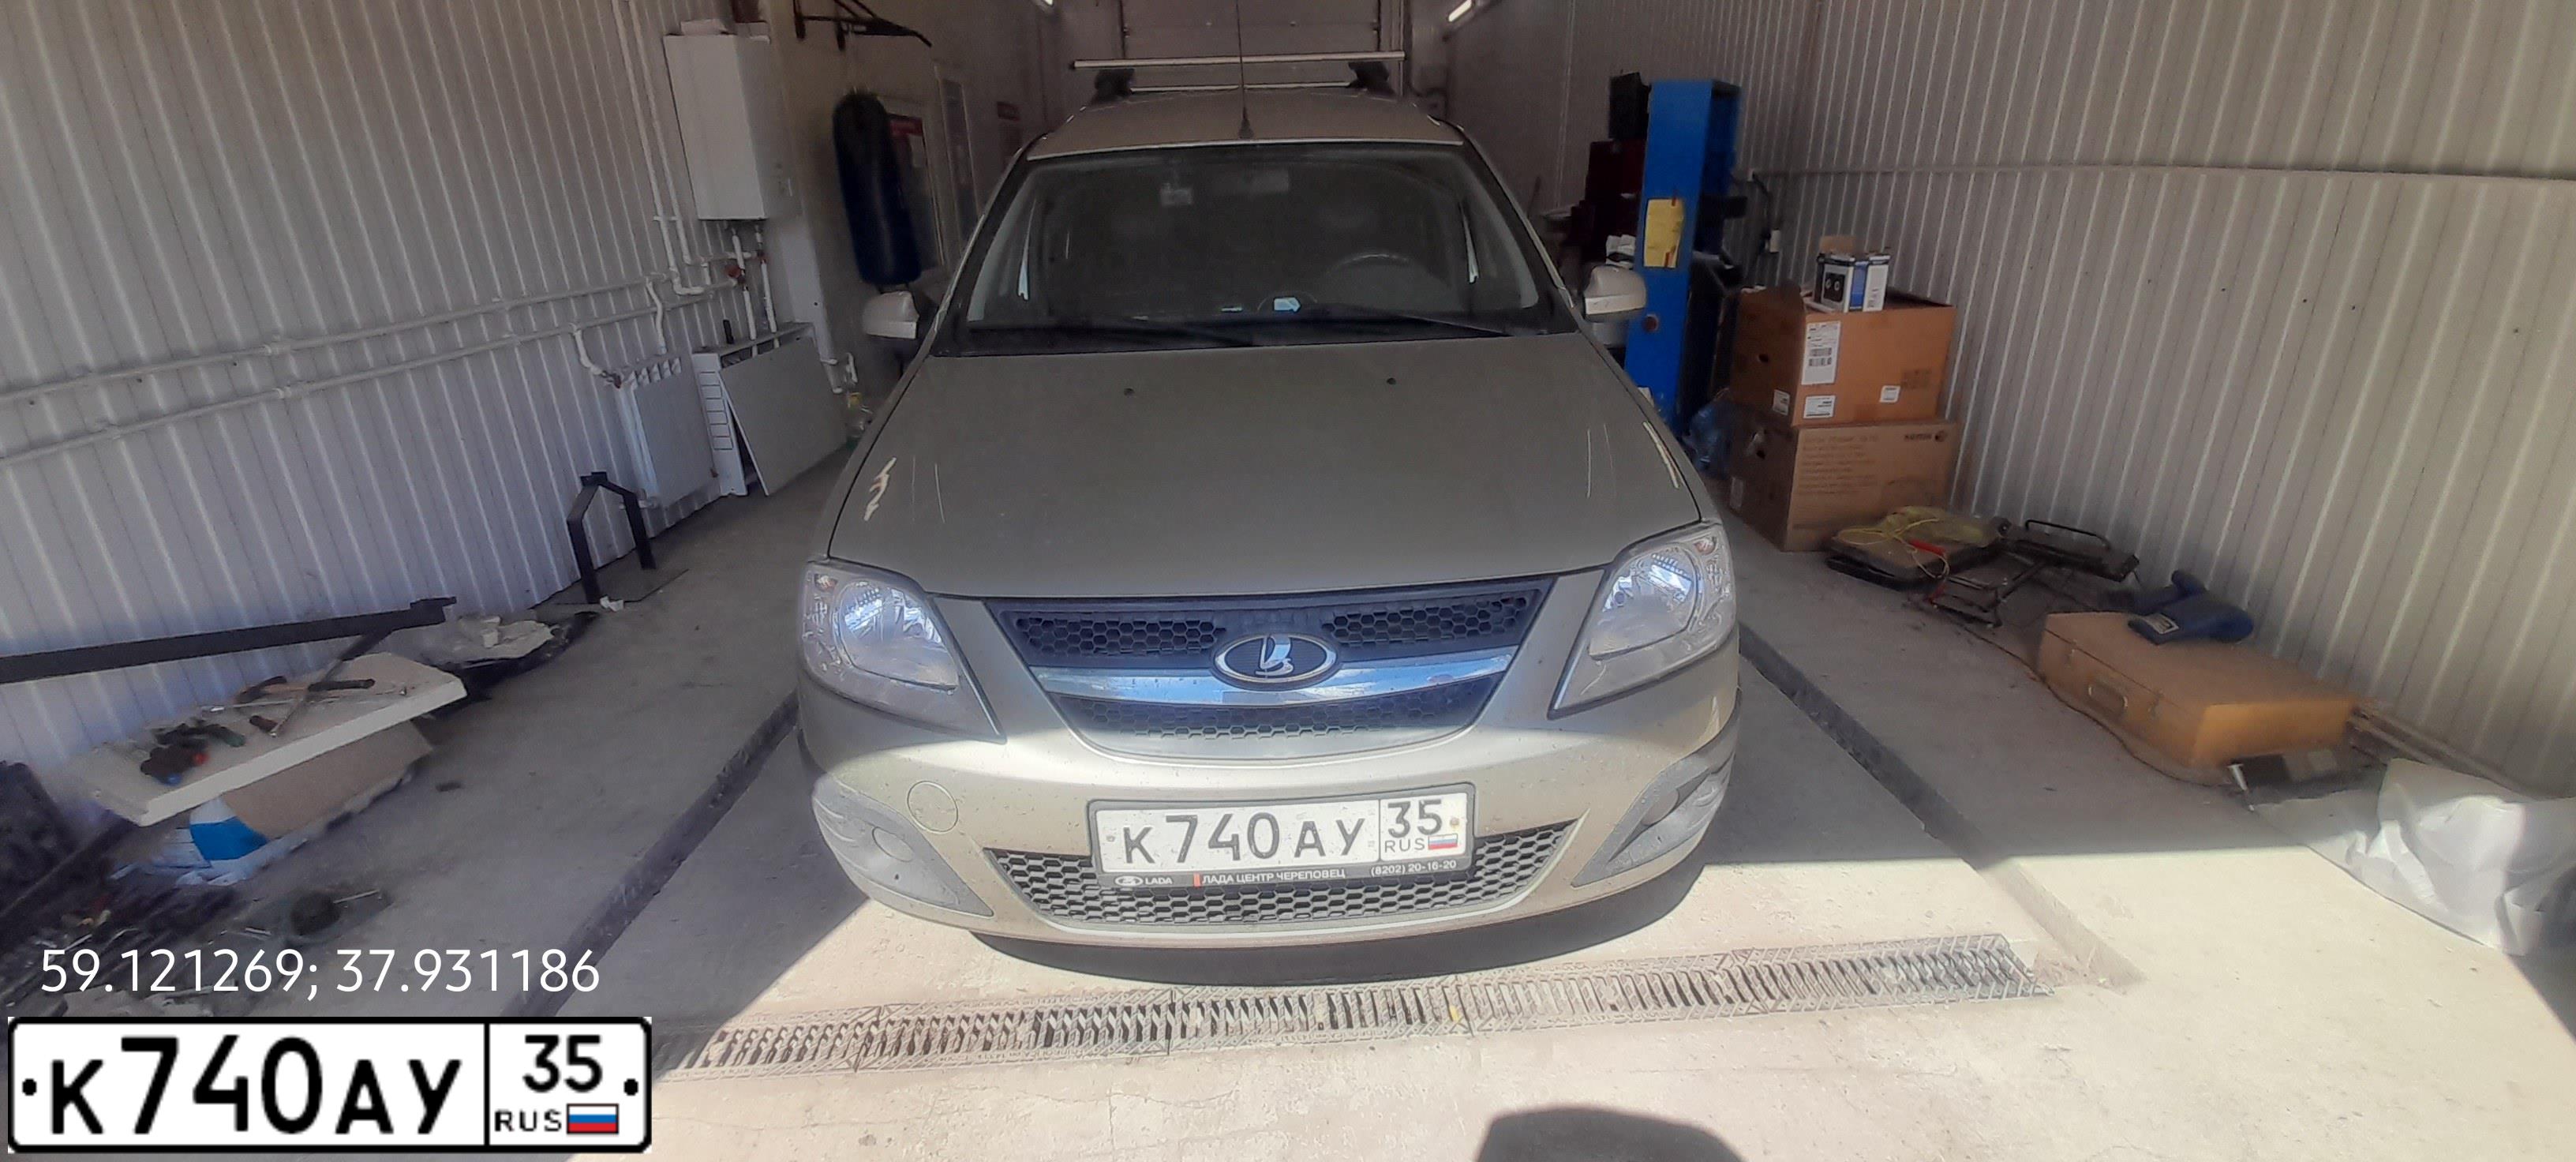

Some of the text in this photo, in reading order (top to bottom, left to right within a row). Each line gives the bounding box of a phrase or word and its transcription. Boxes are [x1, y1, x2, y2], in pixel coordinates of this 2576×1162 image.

[1387, 799, 1443, 838] 35
[1384, 838, 1425, 853] RUS
[1201, 868, 1346, 884] ЛАДА ЦЕНТР ЧЕРЕПОВЕЦ
[1371, 860, 1457, 877] (8202) 20-16-20
[1145, 876, 1173, 886] LADA
